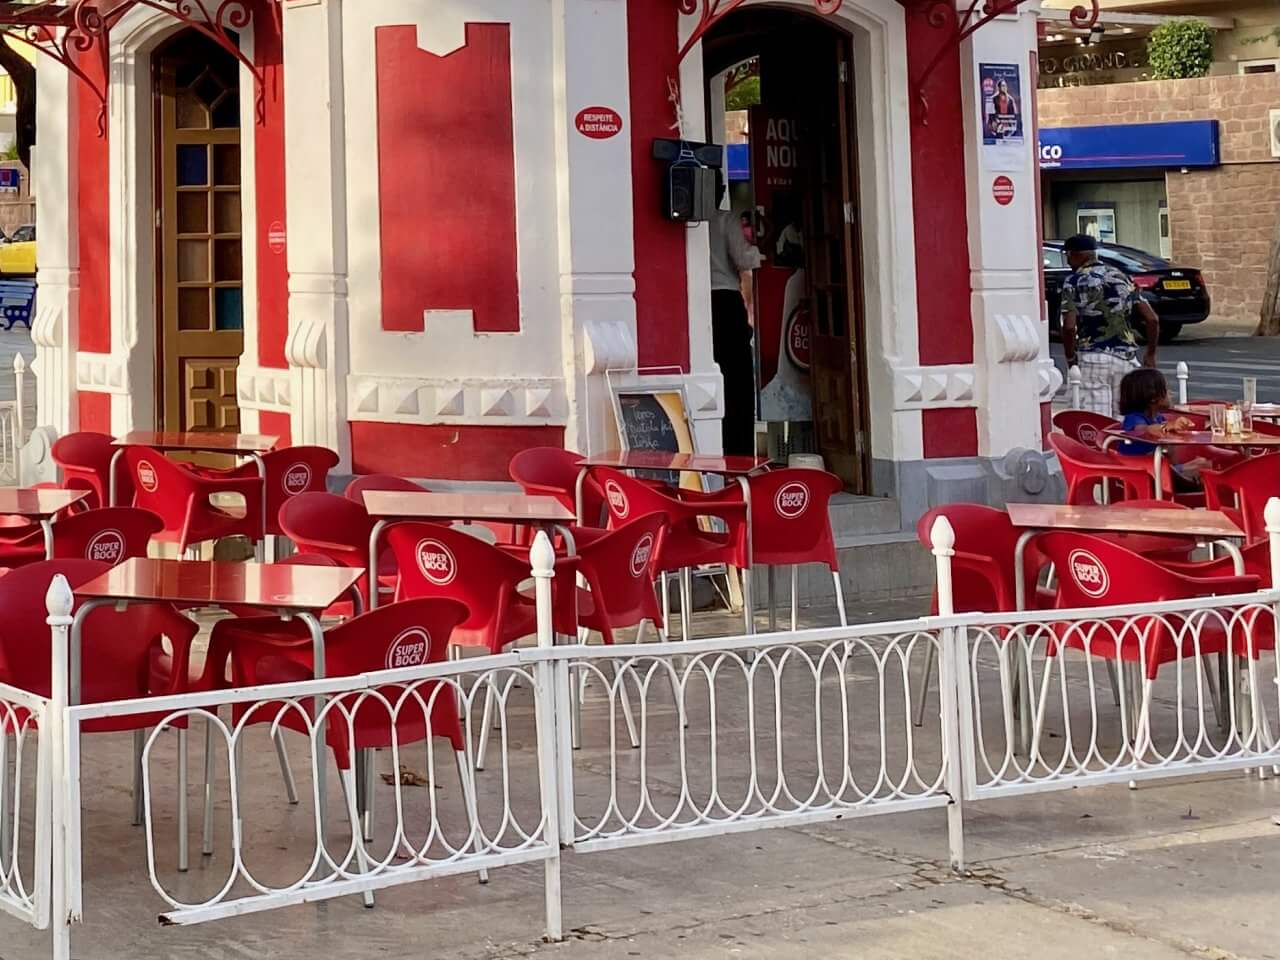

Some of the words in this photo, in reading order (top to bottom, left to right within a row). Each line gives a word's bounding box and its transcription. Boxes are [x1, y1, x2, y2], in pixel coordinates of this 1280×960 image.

[583, 113, 613, 122] RESPEITE
[782, 492, 804, 500] SUPER
[782, 499, 802, 507] BOCK
[94, 542, 120, 551] SUPER
[94, 550, 117, 560] BOCK
[422, 551, 447, 561] SUPER
[424, 559, 449, 571] BOCK
[1075, 562, 1099, 573] SUPER
[1077, 569, 1102, 584] BOCK
[395, 642, 424, 657] SUPER
[395, 653, 422, 666] BOCK
